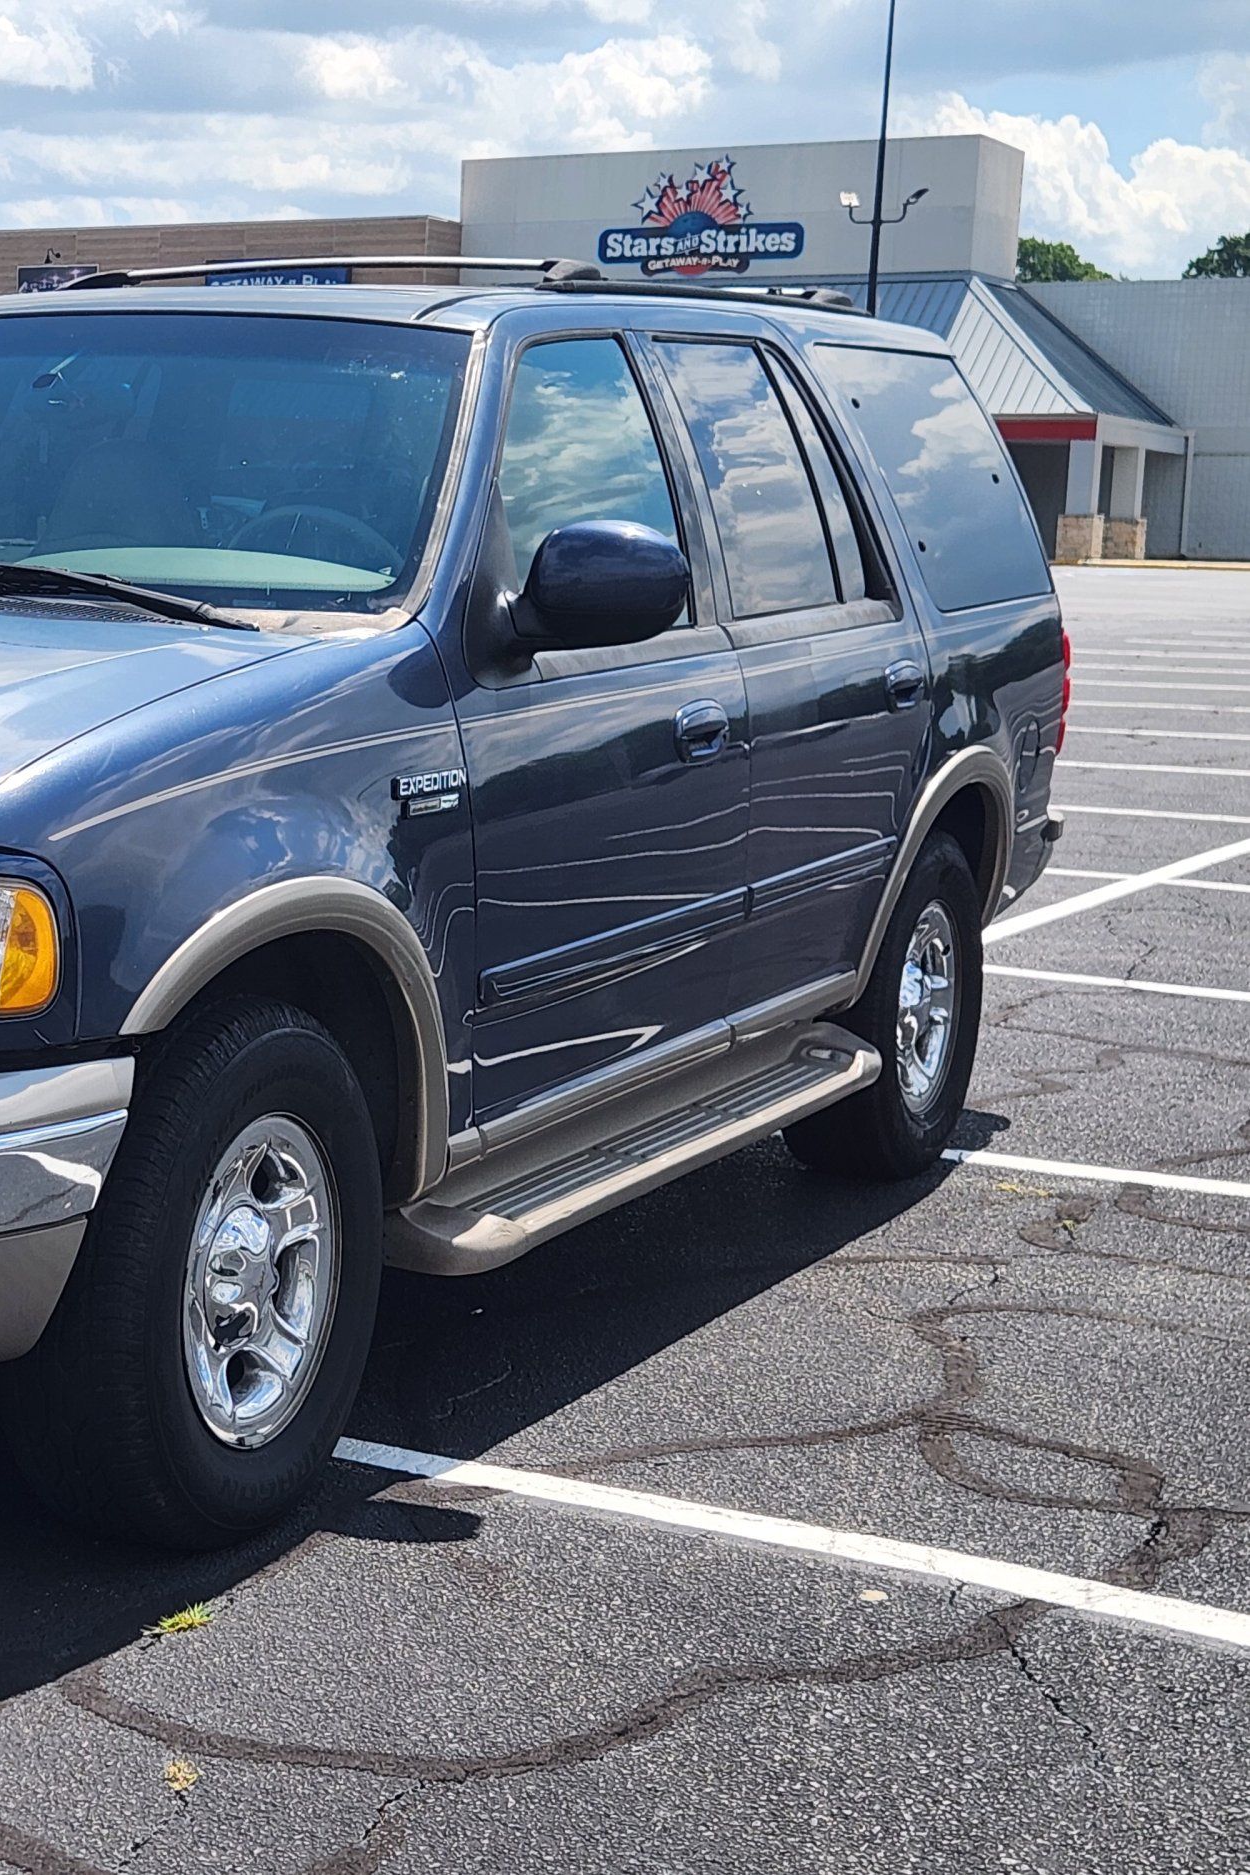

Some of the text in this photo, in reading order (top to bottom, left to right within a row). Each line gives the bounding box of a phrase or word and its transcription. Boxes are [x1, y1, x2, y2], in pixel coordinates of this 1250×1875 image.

[606, 227, 796, 258] Stars AND Strikes
[399, 768, 467, 796] EXPEDITION
